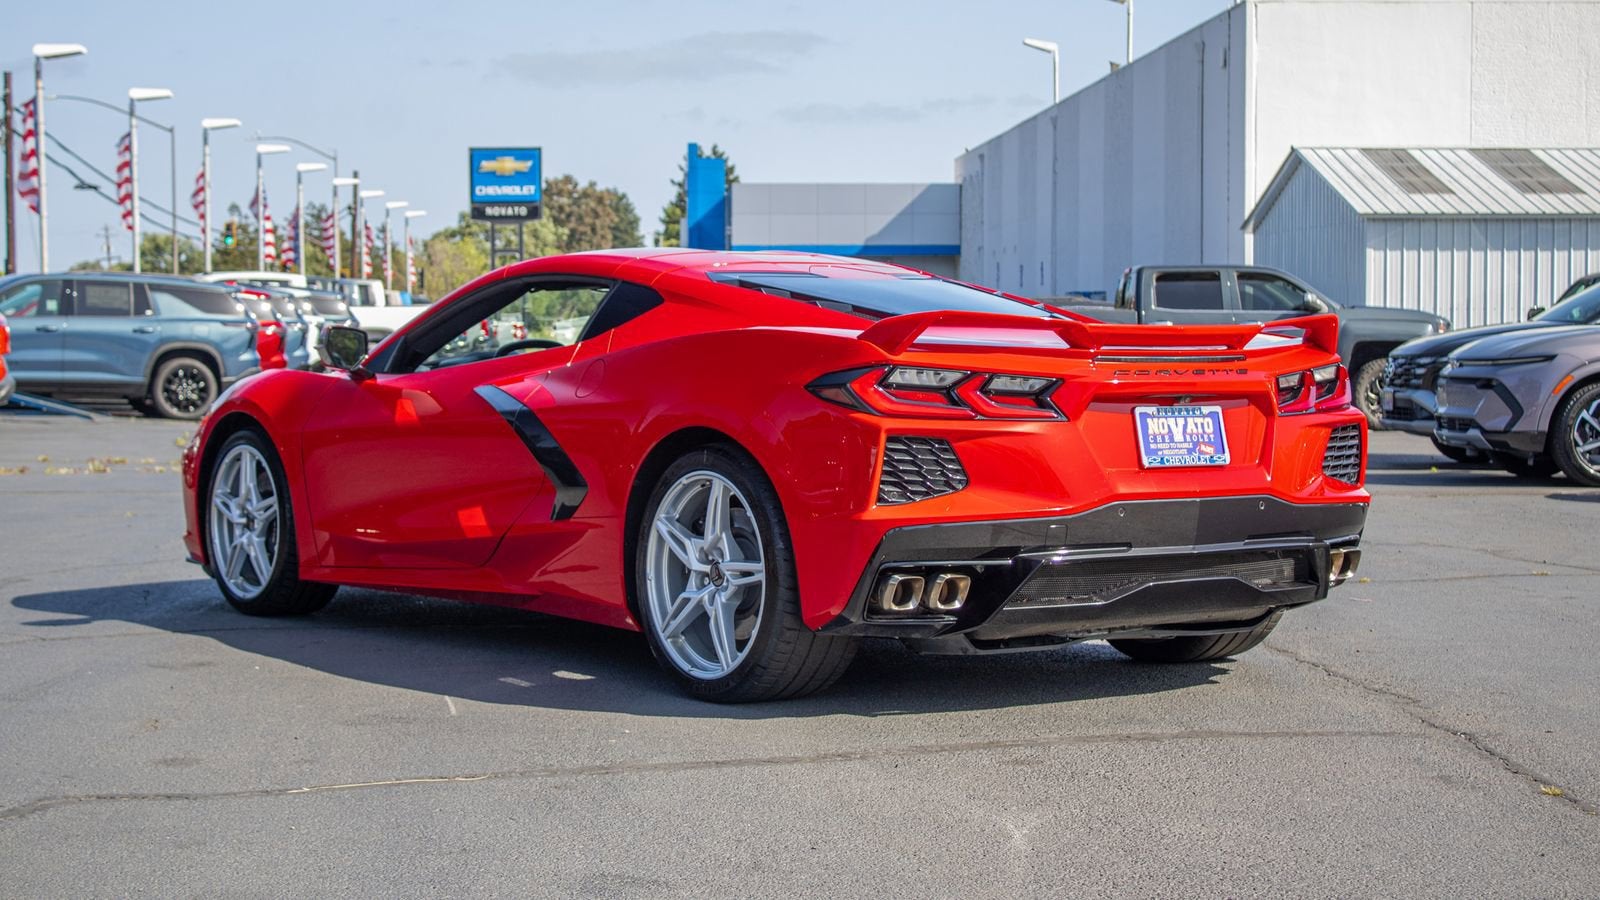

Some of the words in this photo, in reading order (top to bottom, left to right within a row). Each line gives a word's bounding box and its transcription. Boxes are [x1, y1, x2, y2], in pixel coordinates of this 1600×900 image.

[475, 185, 536, 196] CHEVROLET
[485, 206, 527, 217] NOVATO
[1113, 368, 1248, 376] CORVETTE
[1158, 408, 1201, 416] NOVATO
[1147, 417, 1214, 441] NOVATO
[1164, 455, 1210, 465] CHEVROLET
